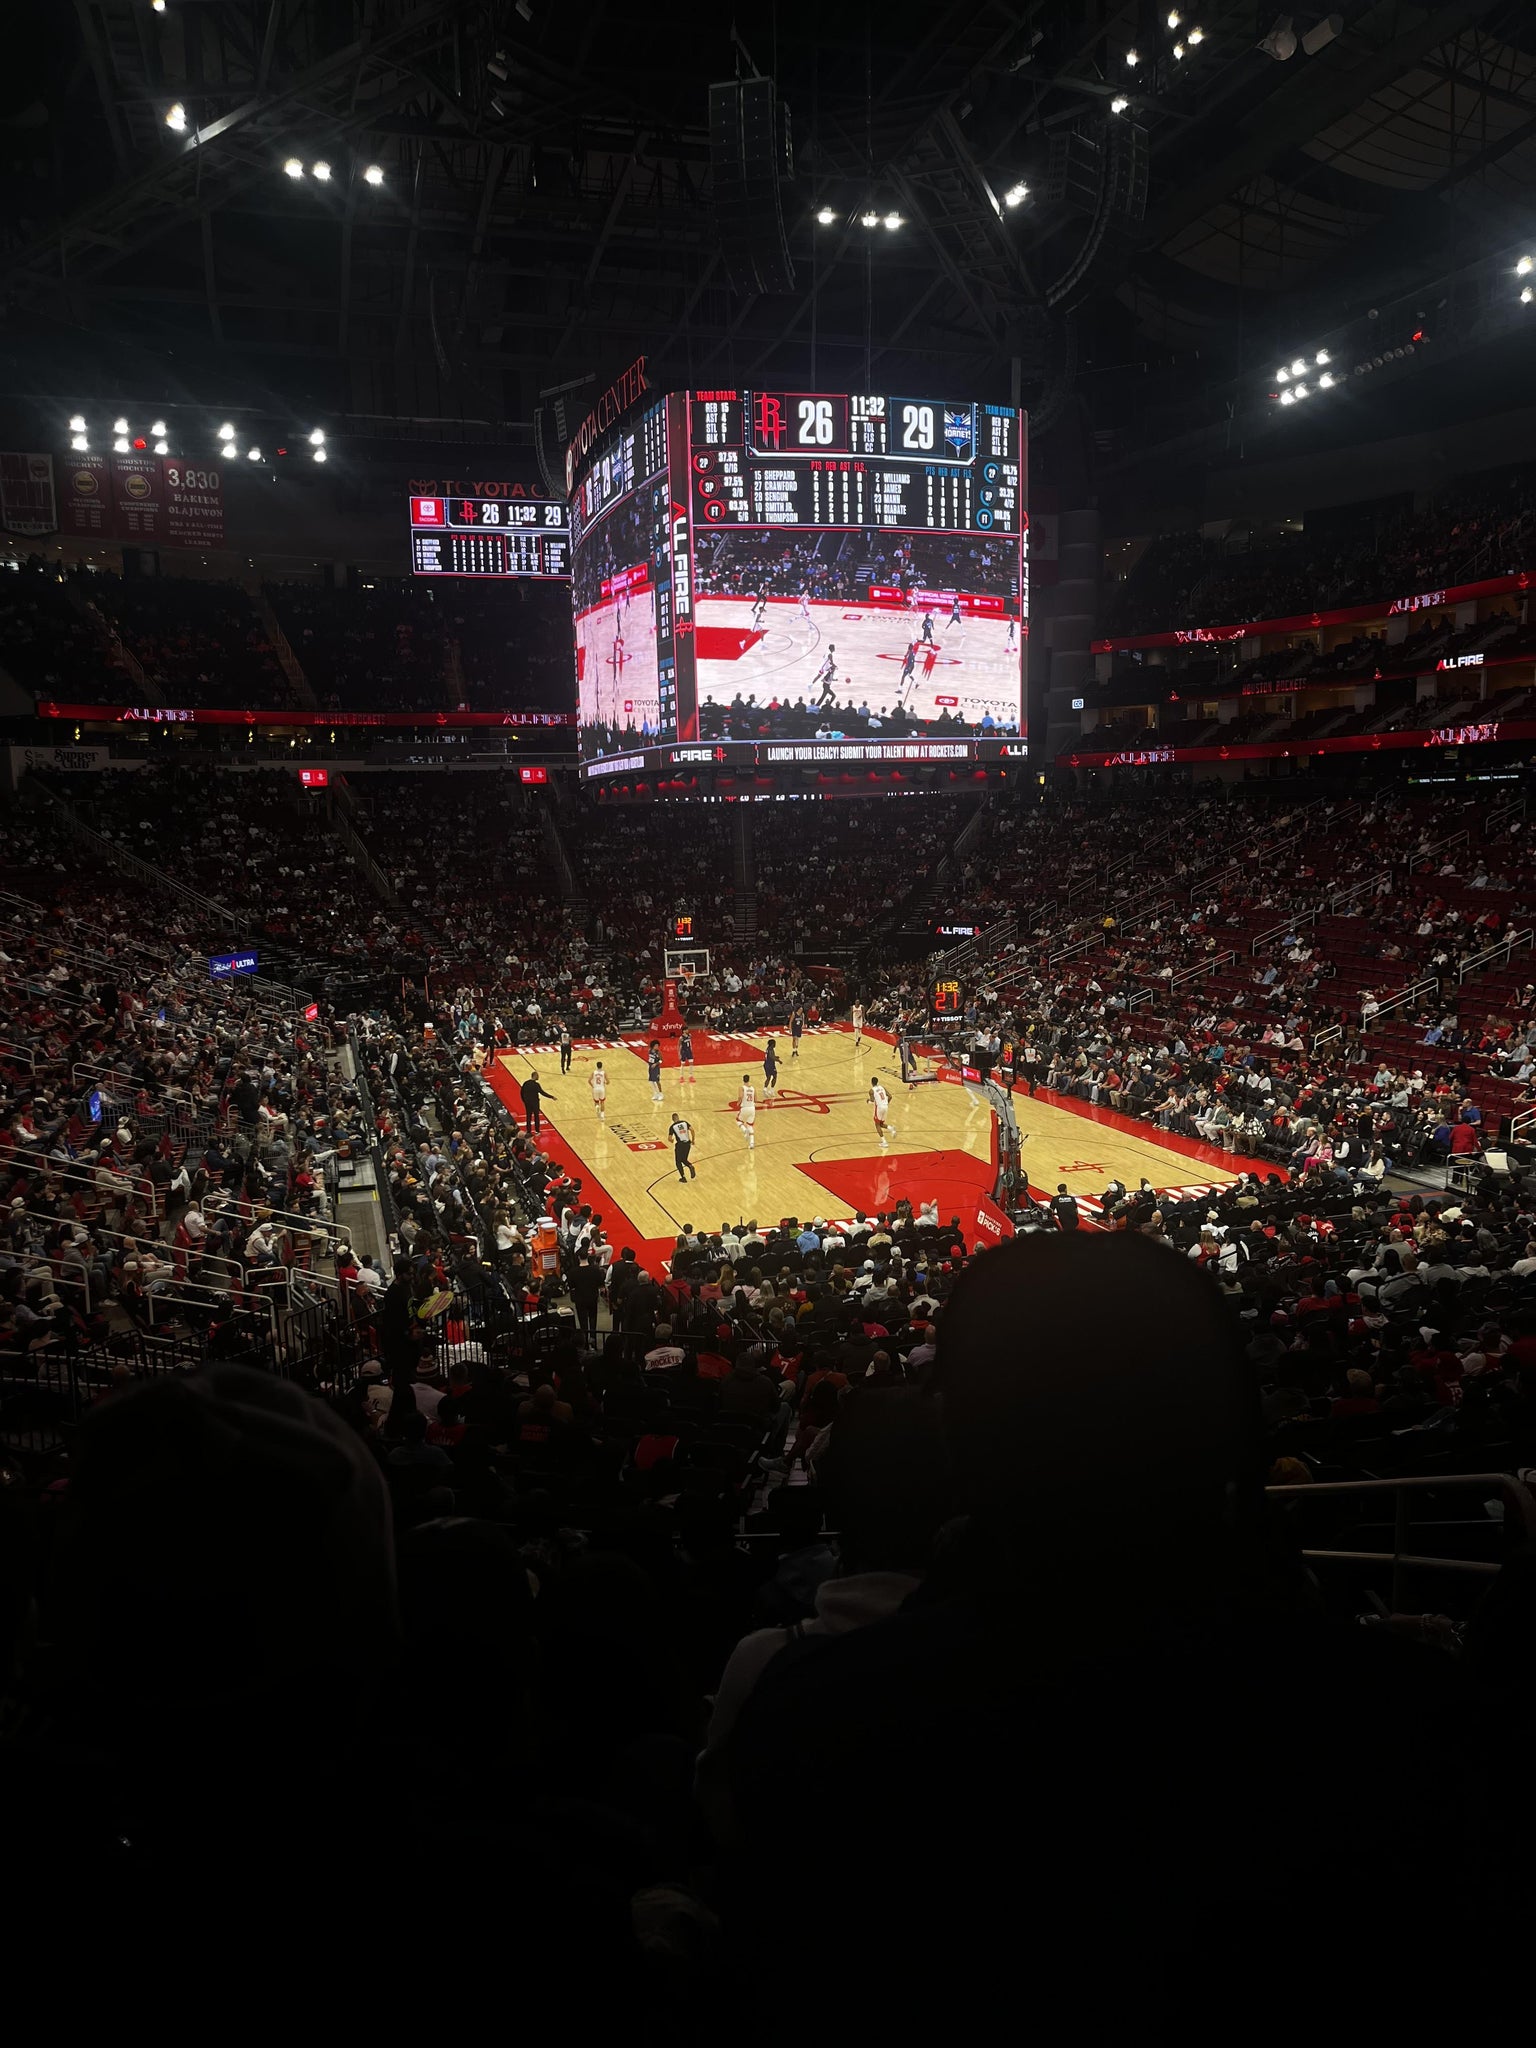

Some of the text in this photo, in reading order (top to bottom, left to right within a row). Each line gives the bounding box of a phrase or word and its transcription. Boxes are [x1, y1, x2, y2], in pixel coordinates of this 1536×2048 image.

[597, 355, 647, 434] CENTER
[696, 391, 736, 401] TEAM STATS
[721, 402, 729, 412] 15
[851, 396, 885, 416] 11:32
[706, 413, 727, 423] AST 4
[798, 400, 833, 445] 26
[706, 424, 717, 433] STL
[863, 422, 875, 433] TOL
[902, 405, 934, 450] 29
[722, 434, 726, 443] 1
[864, 433, 875, 442] FLS
[865, 443, 874, 452] CC
[700, 458, 708, 468] 2P
[810, 461, 822, 470] PTS
[840, 462, 850, 471] AST
[754, 470, 761, 480] 15
[764, 470, 795, 480] SHEPPARD
[813, 470, 819, 481] 2
[828, 471, 833, 481] 2
[926, 466, 935, 476] PTS
[168, 468, 220, 490] 3,830
[875, 473, 880, 482] 2
[883, 473, 910, 484] WILLIAMS
[705, 482, 714, 492] 3P
[754, 481, 762, 491] 27
[764, 481, 798, 491] CRAWFORD
[876, 483, 880, 493] 4
[883, 483, 902, 494] JAMES
[814, 492, 819, 502] 2
[829, 492, 834, 502] 2
[169, 507, 224, 518] OLAJUWON
[711, 506, 718, 516] FT
[765, 502, 784, 512] SMITH
[814, 503, 819, 512] 4
[829, 503, 834, 512] 2
[928, 506, 933, 516] 2
[482, 504, 499, 524] 26
[508, 505, 536, 521] 11:32
[545, 506, 561, 526] 29
[765, 513, 798, 522] THOMPSON
[814, 513, 819, 523] 2
[674, 554, 690, 614] FIRE
[1436, 654, 1484, 671] ALL FIRE
[962, 697, 1017, 708] TOYOTA
[680, 750, 712, 761] FIRE
[768, 747, 793, 760] LAUNCH
[795, 747, 812, 760] YOUR
[814, 746, 839, 760] LEGACY!
[840, 746, 864, 759] SUBMIT
[865, 746, 882, 759] YOUR
[883, 746, 904, 758] TALENT
[920, 745, 928, 758] AT
[929, 745, 968, 758] ROCKETS.COM
[1000, 745, 1021, 756] ALL
[936, 926, 973, 935] ALL FIRE
[236, 958, 254, 968] ULTRA
[936, 982, 958, 992] 11:32
[935, 992, 957, 1010] 21
[780, 1361, 789, 1374] 7
